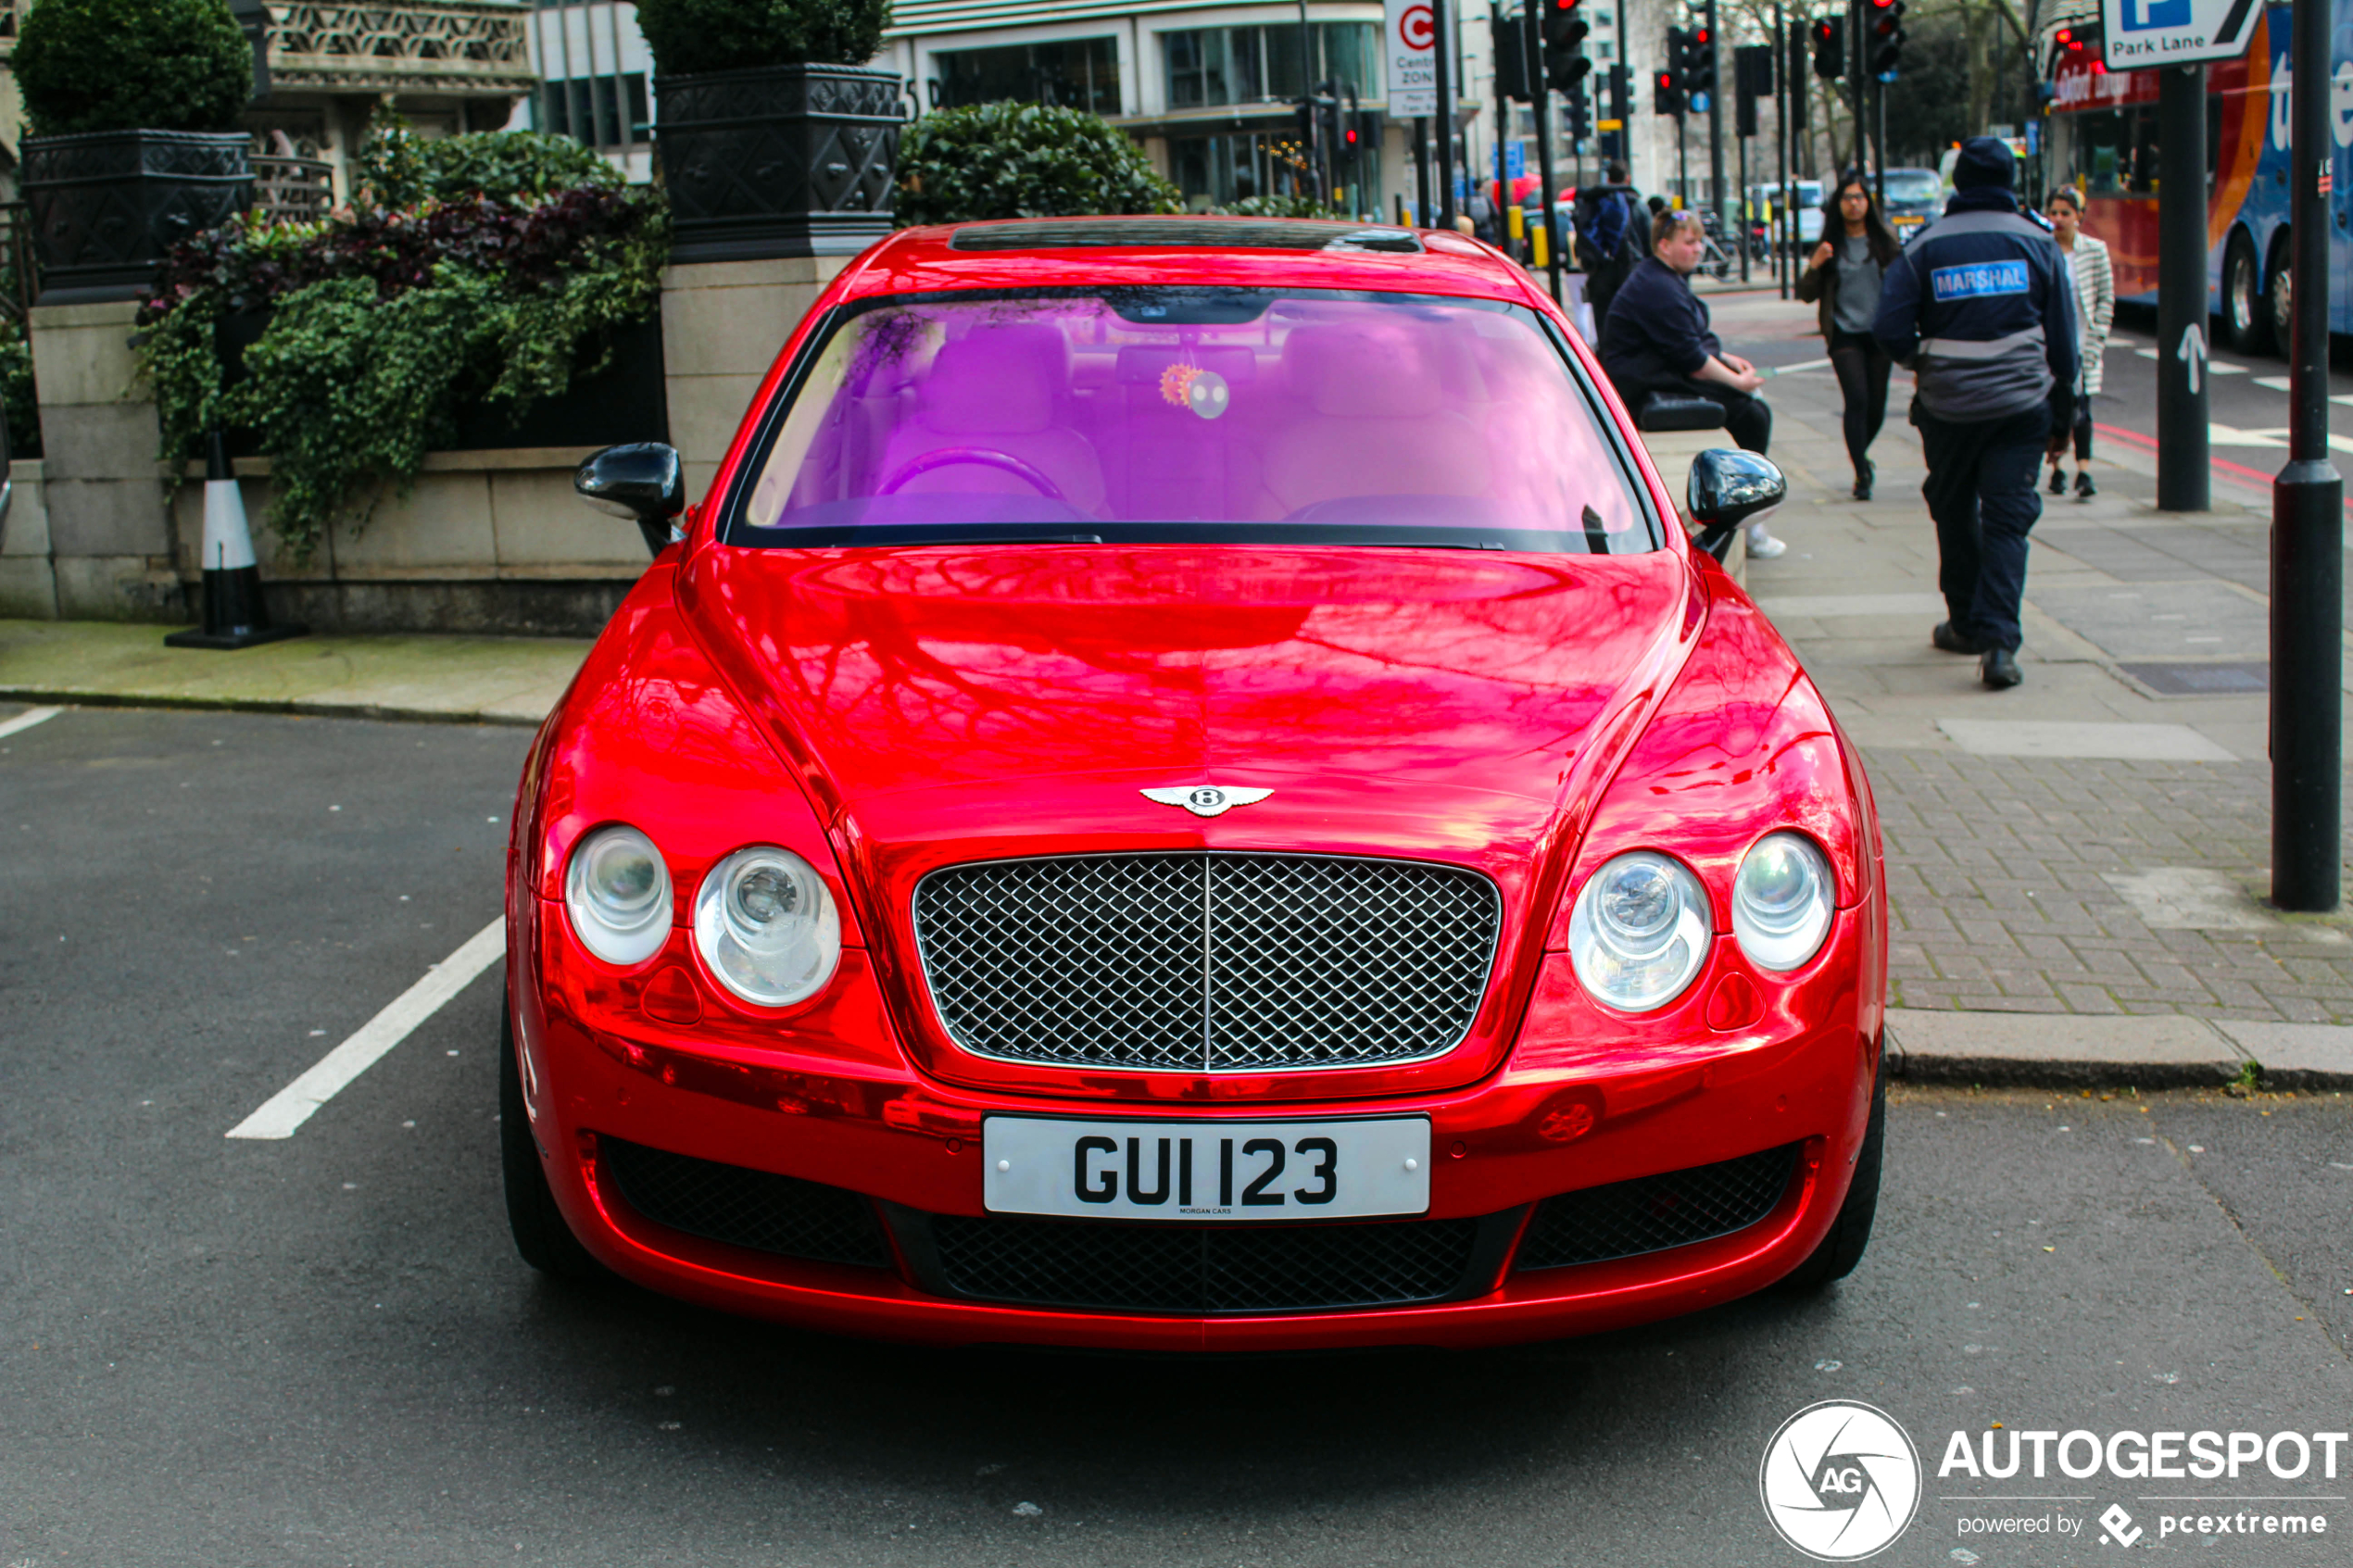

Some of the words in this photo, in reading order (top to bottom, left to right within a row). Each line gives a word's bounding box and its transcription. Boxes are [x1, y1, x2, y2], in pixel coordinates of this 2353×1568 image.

[2113, 39, 2155, 56] Park
[2161, 36, 2205, 51] Lane
[1402, 71, 1433, 83] ZON
[1937, 267, 2025, 294] MARSHAL
